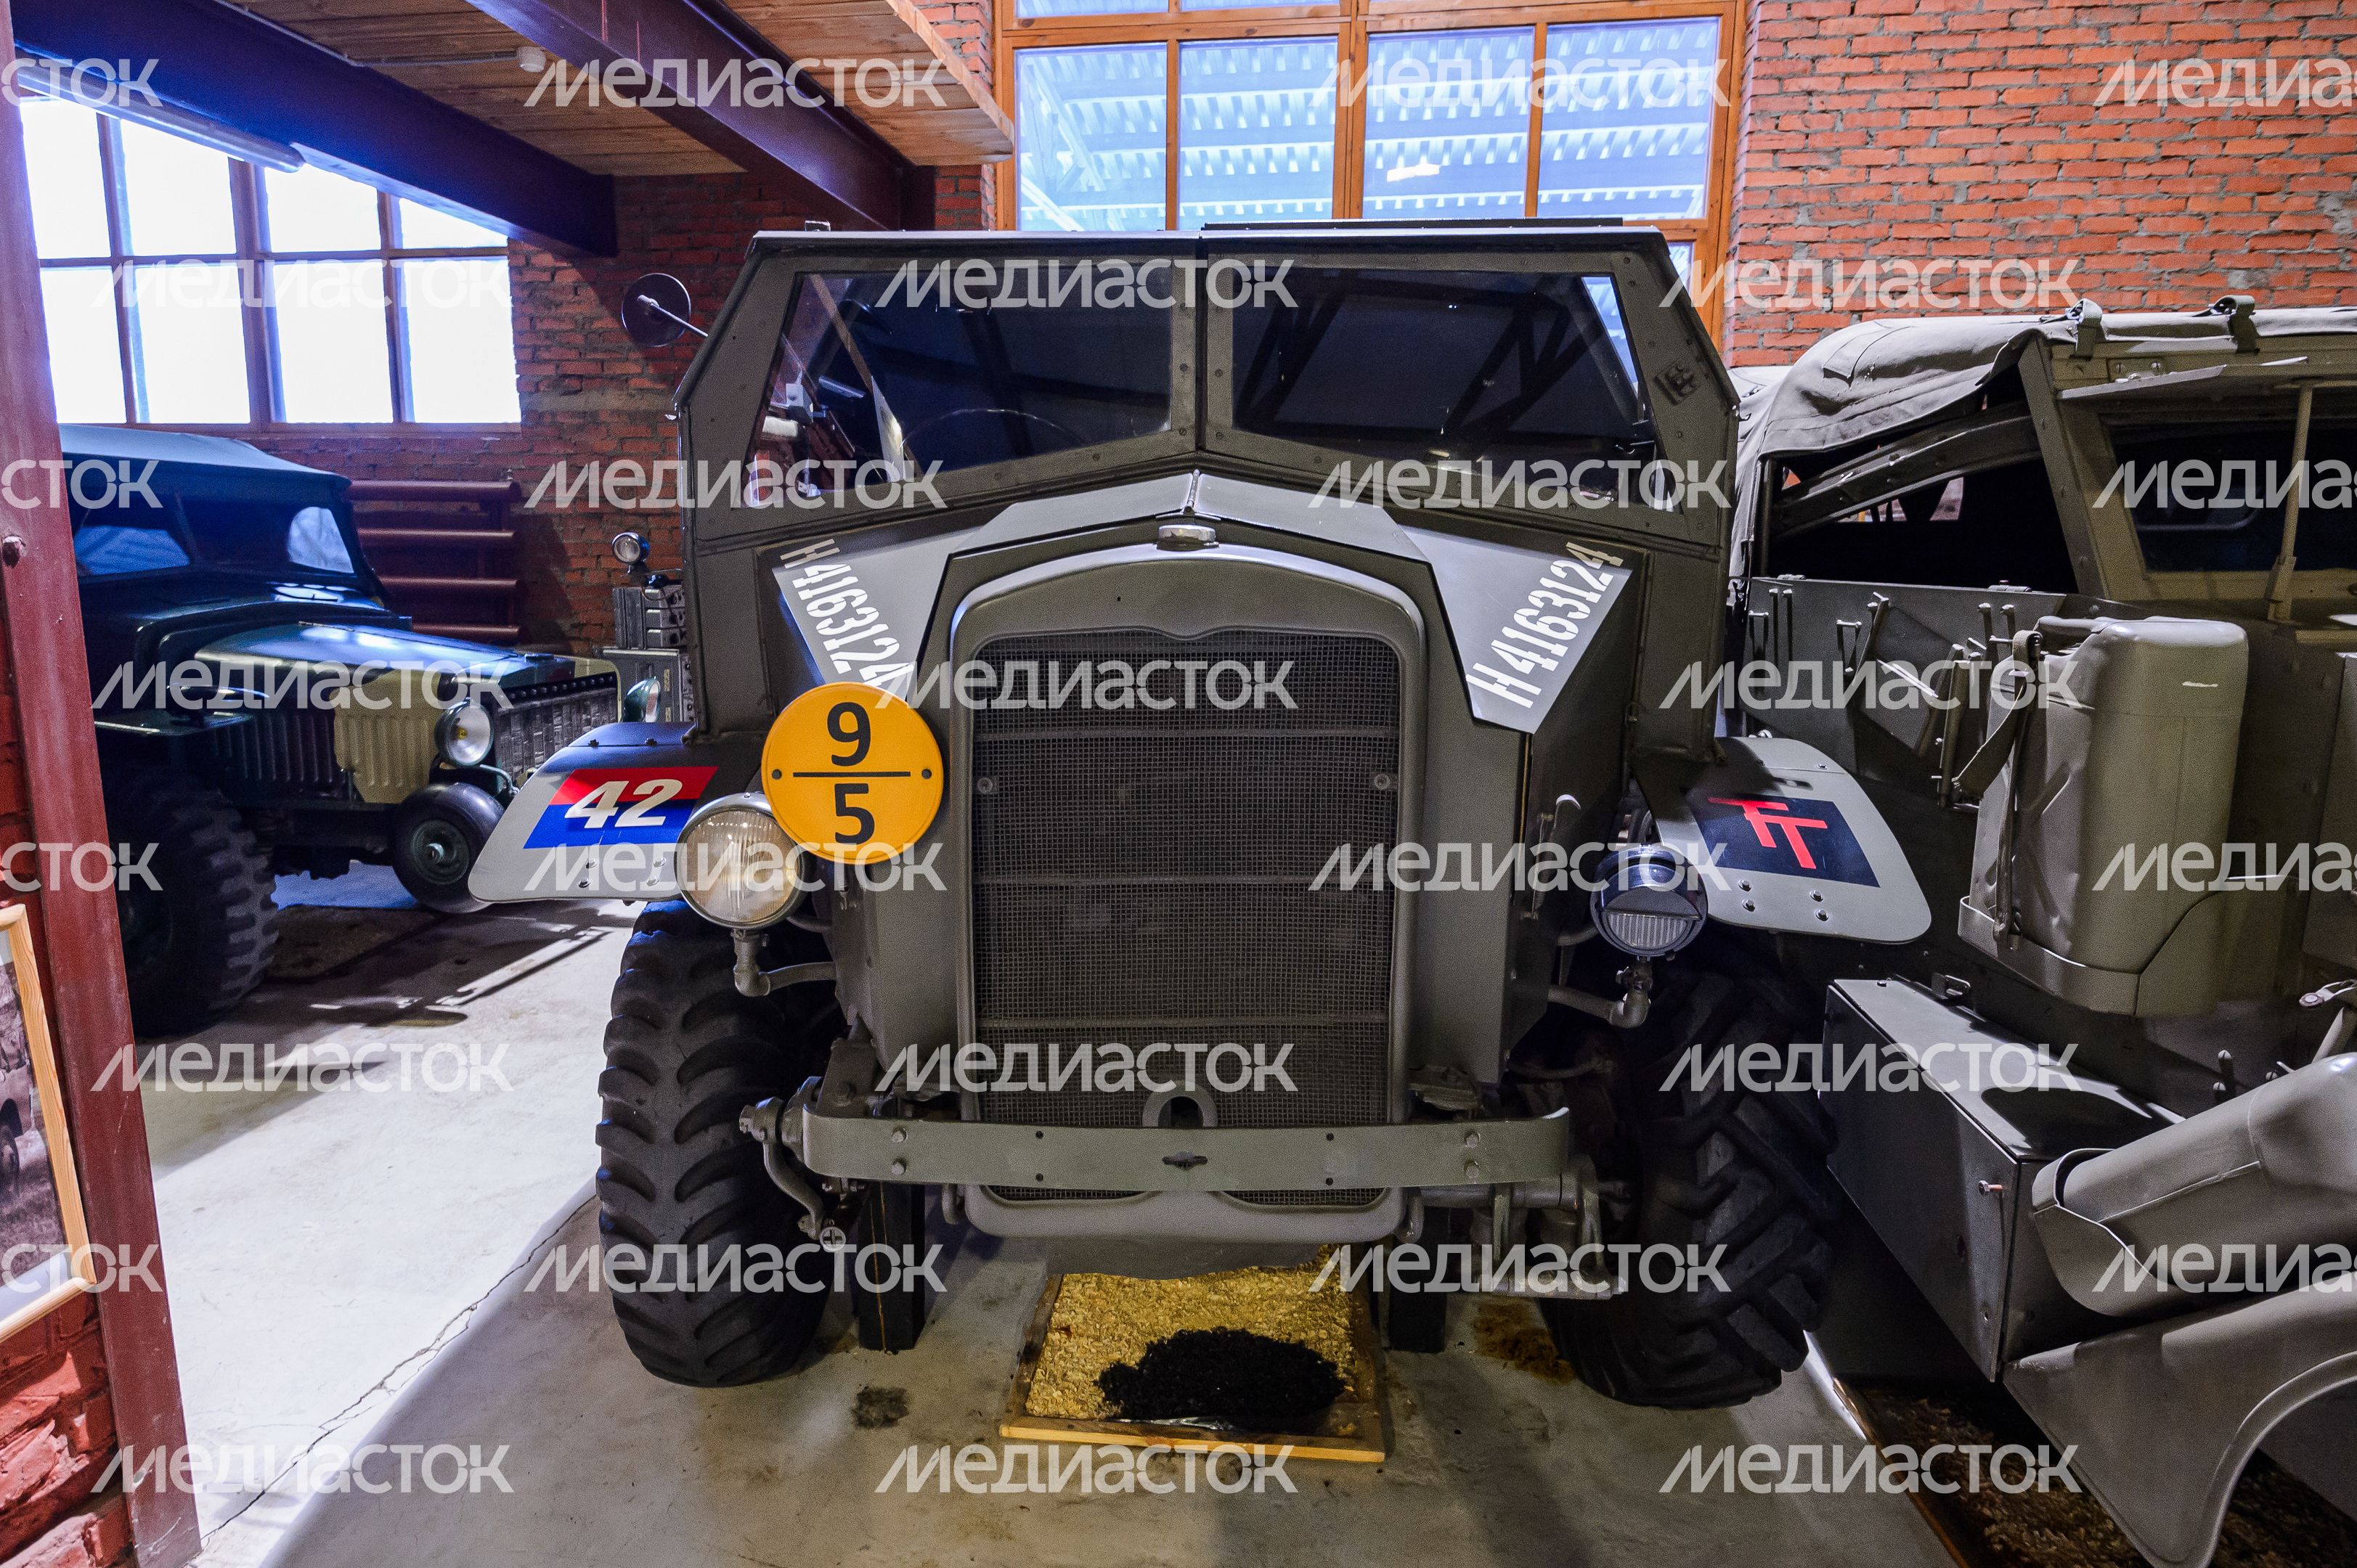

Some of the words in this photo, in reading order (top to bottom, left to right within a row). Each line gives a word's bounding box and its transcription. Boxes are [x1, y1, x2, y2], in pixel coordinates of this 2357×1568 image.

[827, 702, 871, 767] 9
[564, 779, 683, 828] 42
[834, 783, 875, 845] 5
